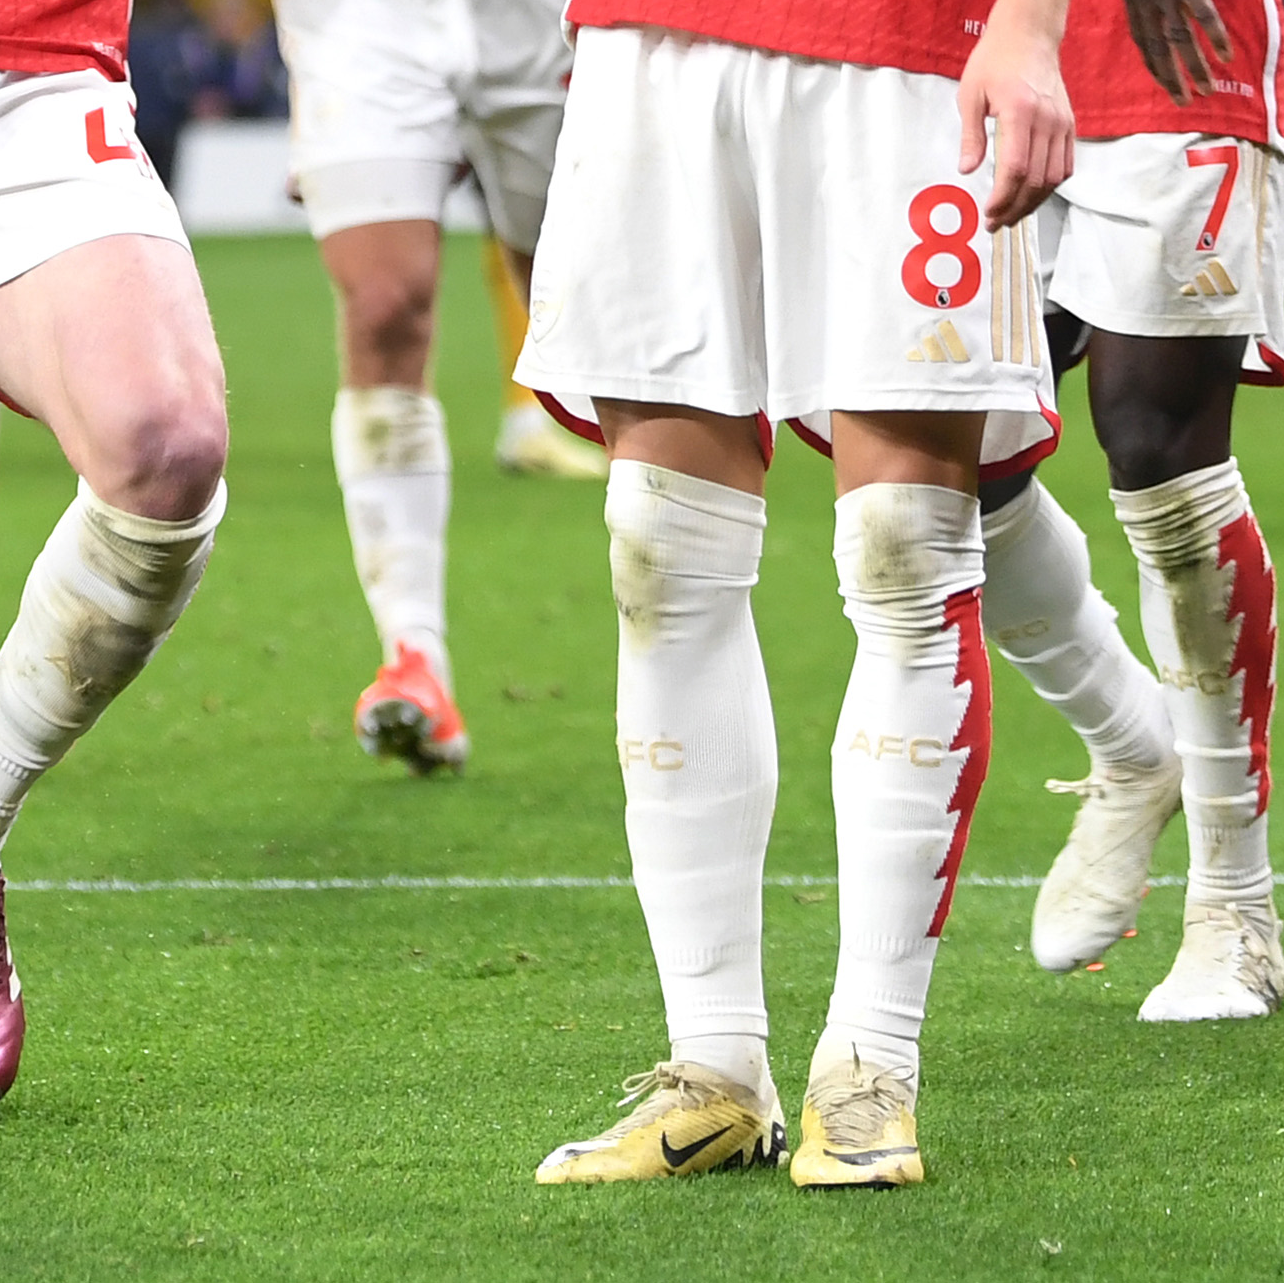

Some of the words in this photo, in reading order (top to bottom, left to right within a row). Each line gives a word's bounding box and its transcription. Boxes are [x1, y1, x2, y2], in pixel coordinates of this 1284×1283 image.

[901, 184, 982, 309] 8
[1185, 145, 1240, 251] 7
[848, 729, 945, 768] AFC
